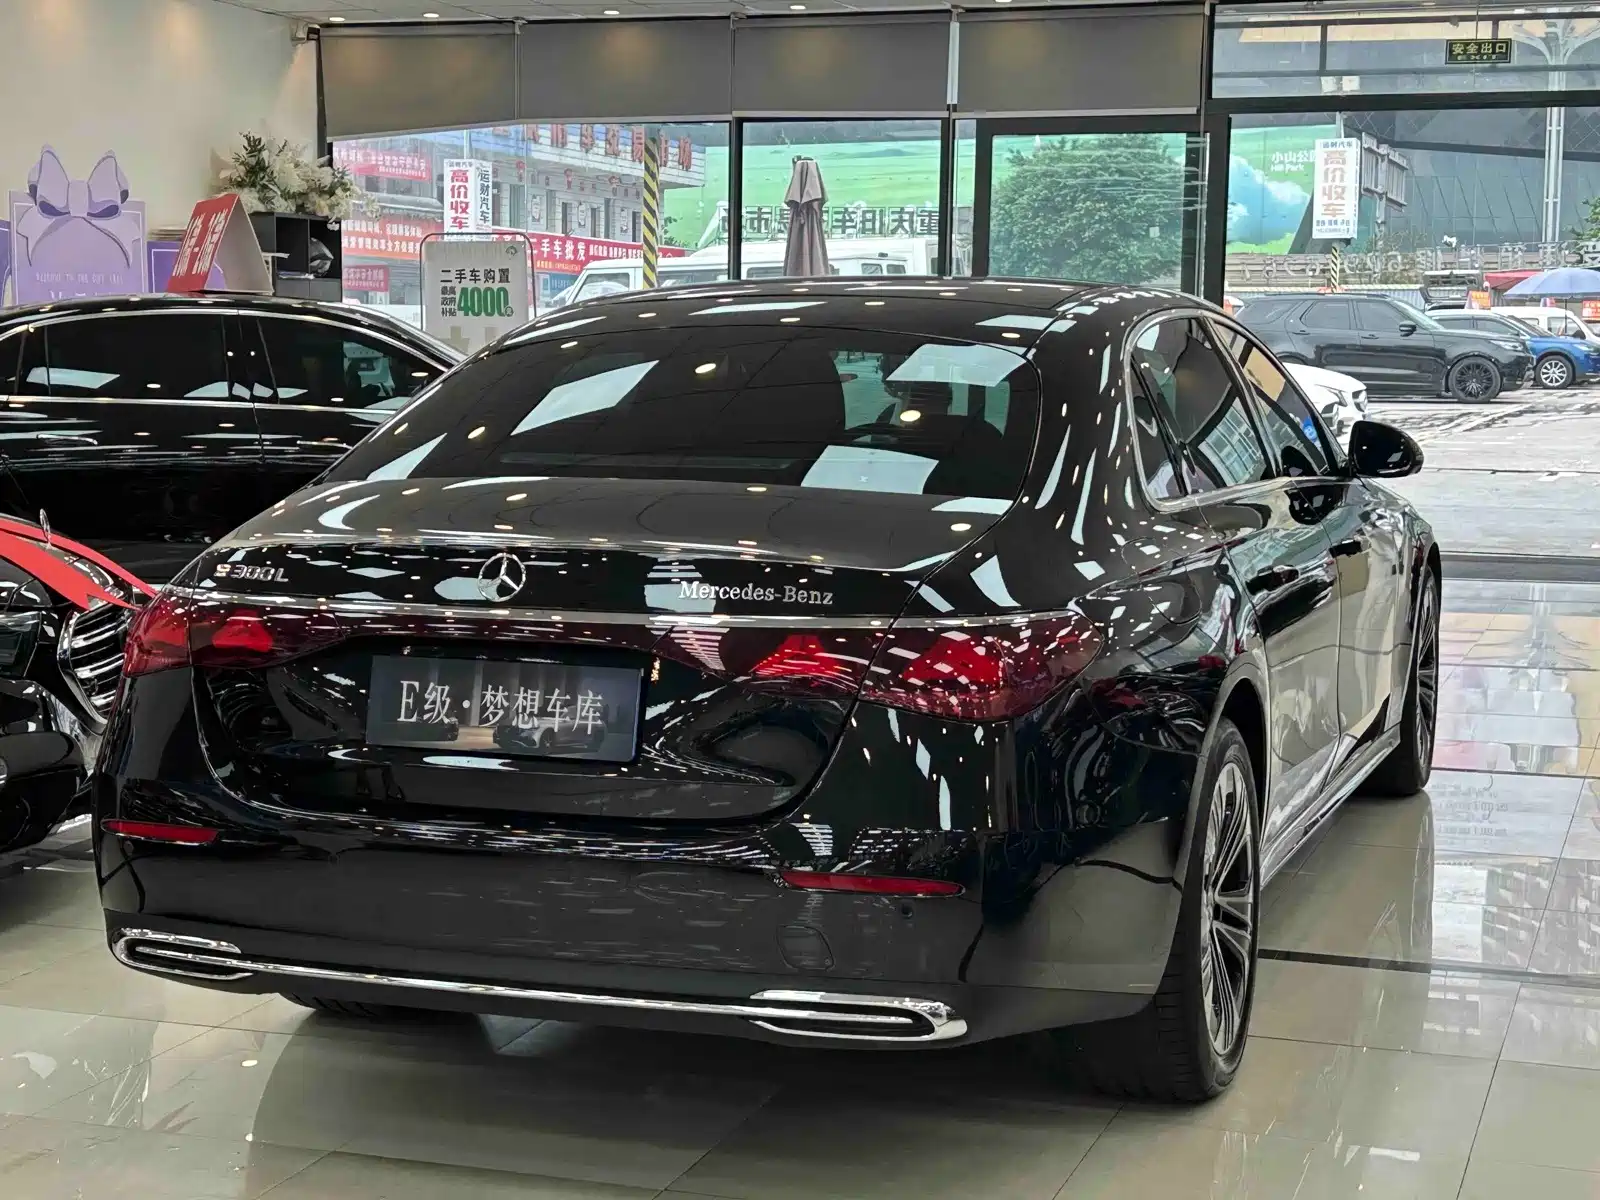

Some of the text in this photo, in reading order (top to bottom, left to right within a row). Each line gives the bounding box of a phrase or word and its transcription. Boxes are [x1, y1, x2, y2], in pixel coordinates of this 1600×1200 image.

[1452, 43, 1507, 54] 安全出口
[1321, 150, 1347, 217] 高价收车
[449, 169, 470, 230] 高价收车
[440, 268, 510, 284] 二手车购置
[440, 286, 456, 296] 最高
[440, 297, 456, 307] 政府
[457, 287, 509, 317] 4000
[440, 307, 457, 317] 补贴
[679, 580, 834, 605] Mercedes-Benz
